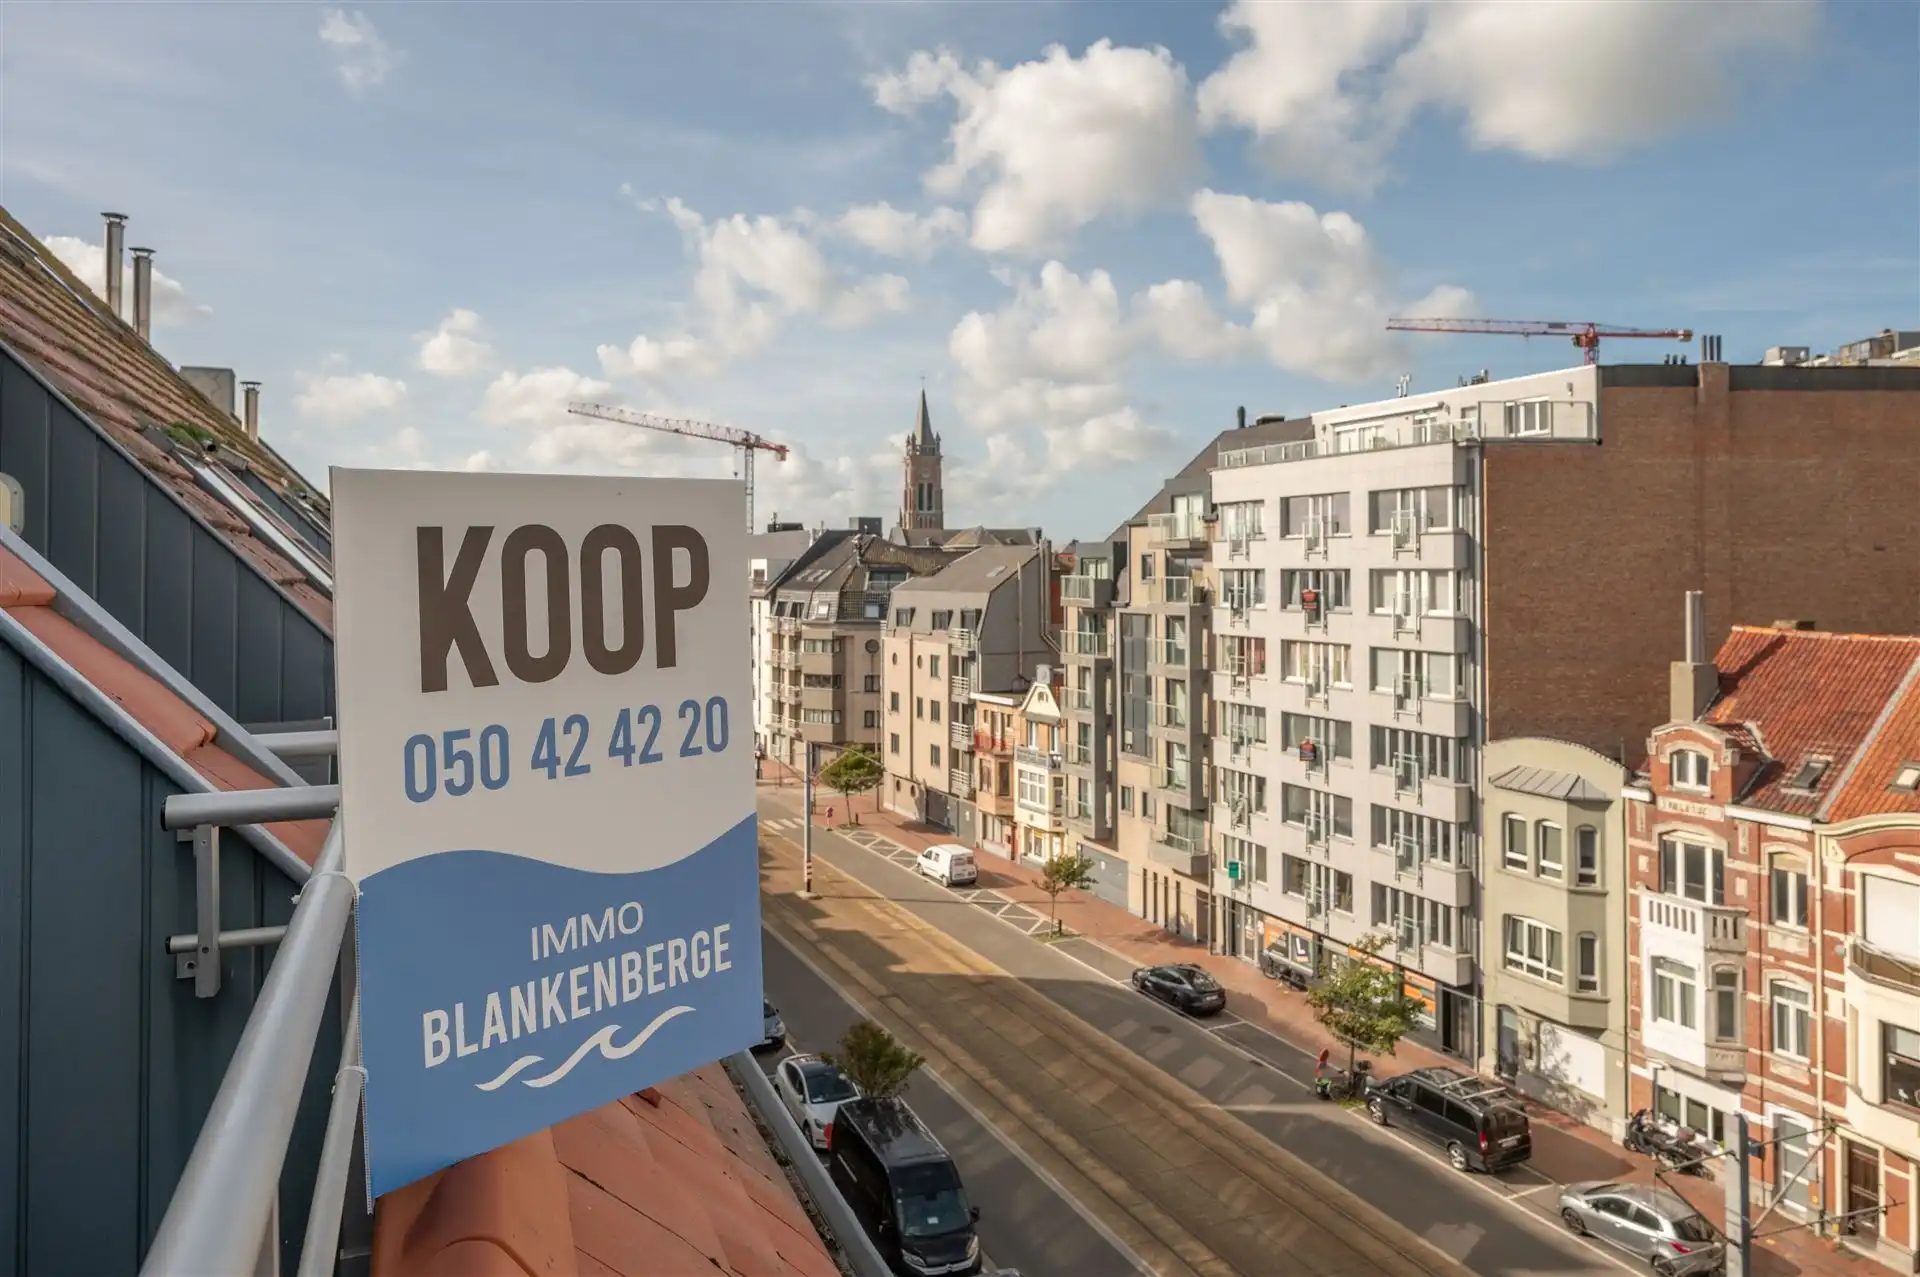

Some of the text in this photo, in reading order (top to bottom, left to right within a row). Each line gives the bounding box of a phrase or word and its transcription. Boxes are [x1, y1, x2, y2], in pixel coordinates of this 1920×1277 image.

[416, 523, 710, 694] KOOP
[403, 696, 730, 804] 050 42 42 20
[530, 901, 644, 962] IMMO
[422, 923, 733, 1069] BLANKENBERGE
